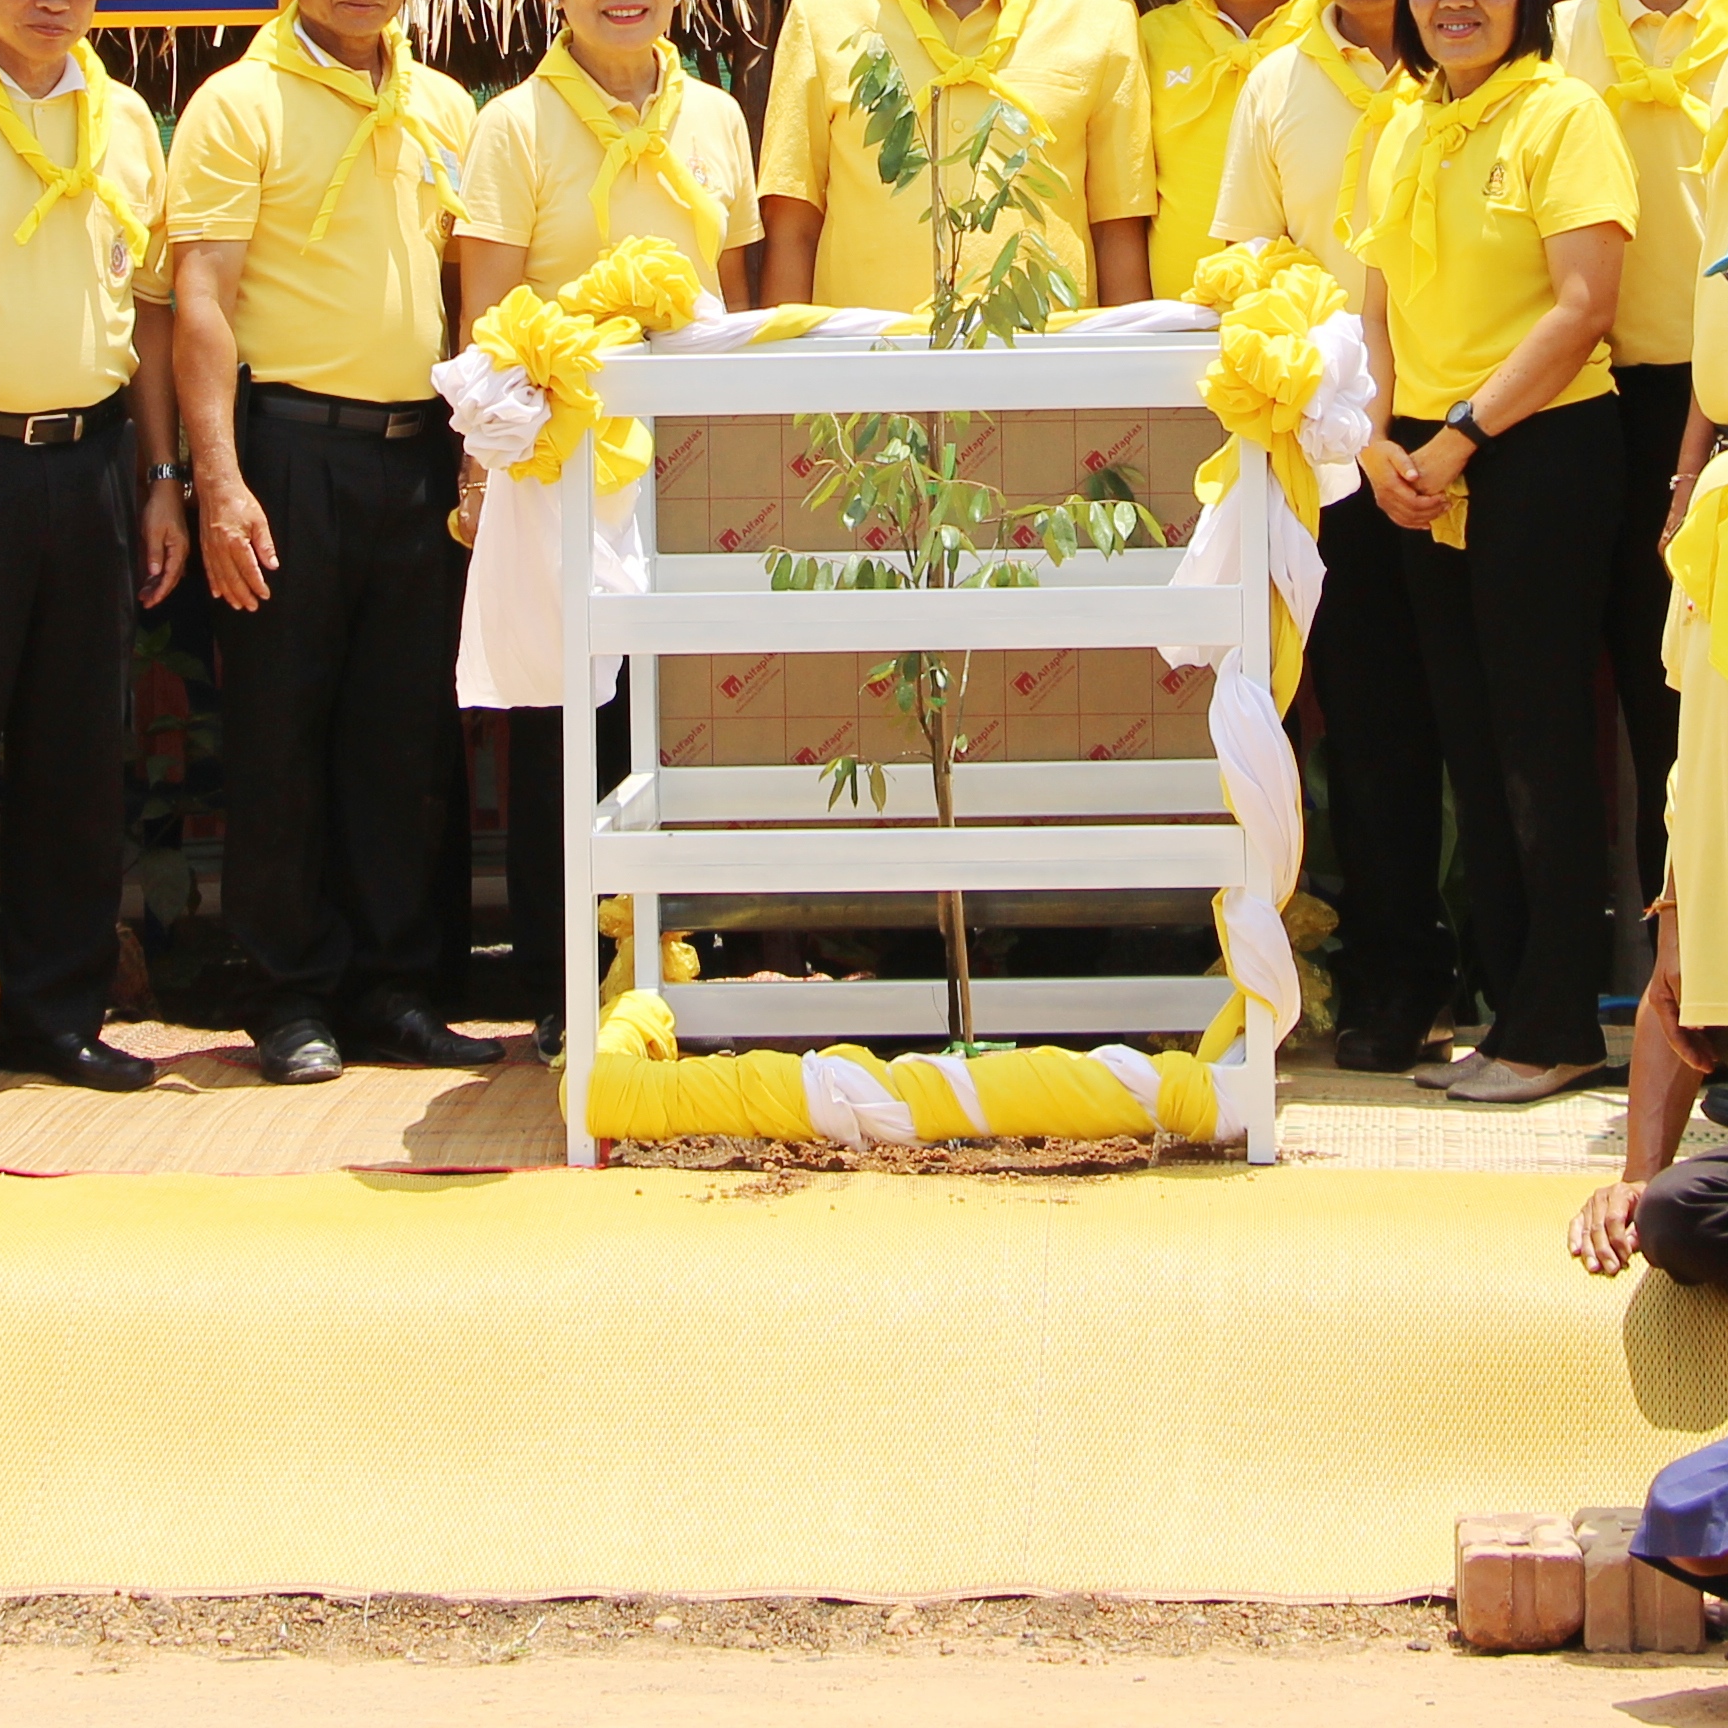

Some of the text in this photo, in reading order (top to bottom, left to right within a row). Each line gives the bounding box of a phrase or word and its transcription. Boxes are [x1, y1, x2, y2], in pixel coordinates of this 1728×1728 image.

[667, 428, 703, 465] Alfaplas
[961, 425, 996, 461] Alfaplas
[1107, 423, 1143, 460] Alfaplas
[741, 502, 777, 538] Alfaplas
[743, 652, 779, 683] Alfapl
[1036, 648, 1072, 681] Alfapl
[671, 722, 707, 757] Alfaplas
[818, 720, 854, 757] Alfaplas
[966, 719, 1000, 753] lfaplas
[1111, 718, 1148, 753] Alfaplas
